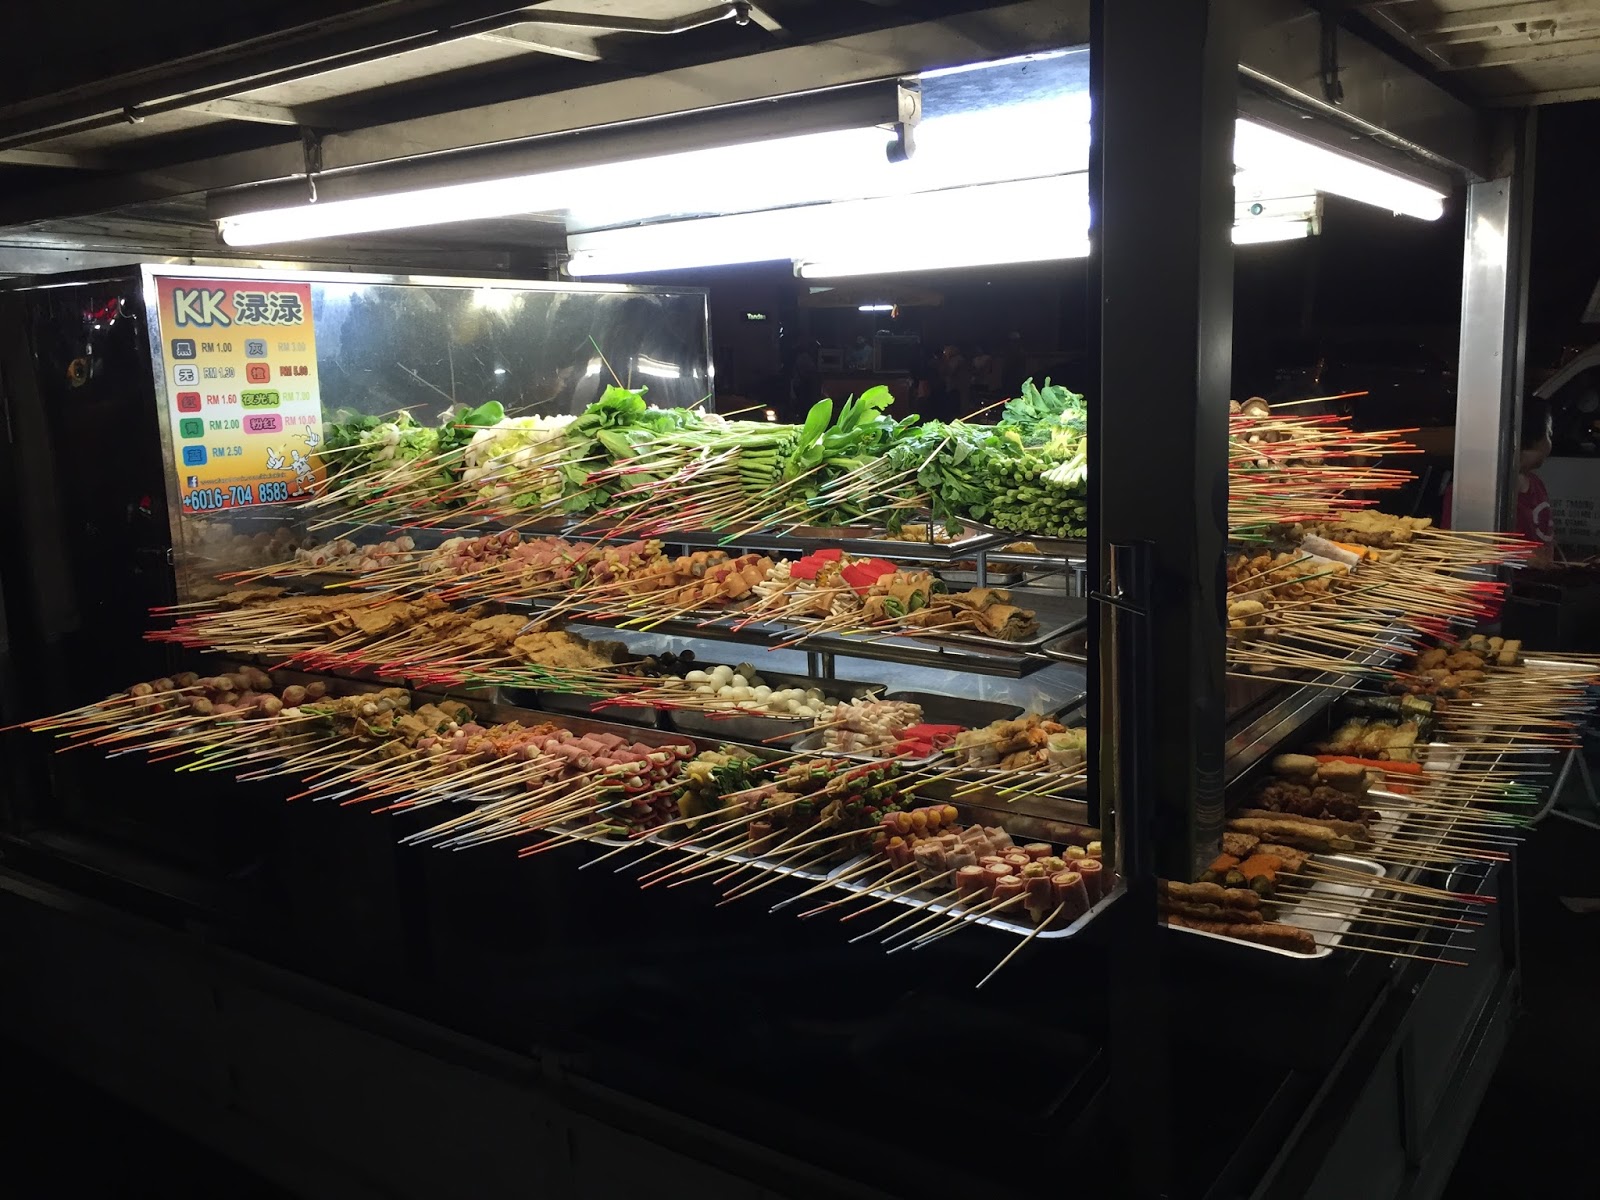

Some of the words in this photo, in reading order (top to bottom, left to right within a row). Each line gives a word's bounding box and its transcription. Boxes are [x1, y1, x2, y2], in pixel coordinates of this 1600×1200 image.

[173, 288, 231, 327] KK
[201, 342, 214, 352] RM
[216, 342, 232, 352] 1.00
[248, 342, 263, 355] 灰
[179, 368, 194, 381] 无
[204, 367, 217, 378] RM
[279, 366, 292, 376] RM
[207, 395, 219, 404] RM
[222, 394, 237, 404] 1.60
[282, 391, 294, 401] RM
[209, 420, 222, 430] RM
[224, 419, 239, 430] 2.00
[285, 416, 296, 426] RM
[298, 415, 316, 425] 10.00
[212, 447, 225, 457] RM
[227, 446, 242, 456] 2.50
[183, 485, 253, 510] +6016-704
[258, 481, 288, 503] 8583
